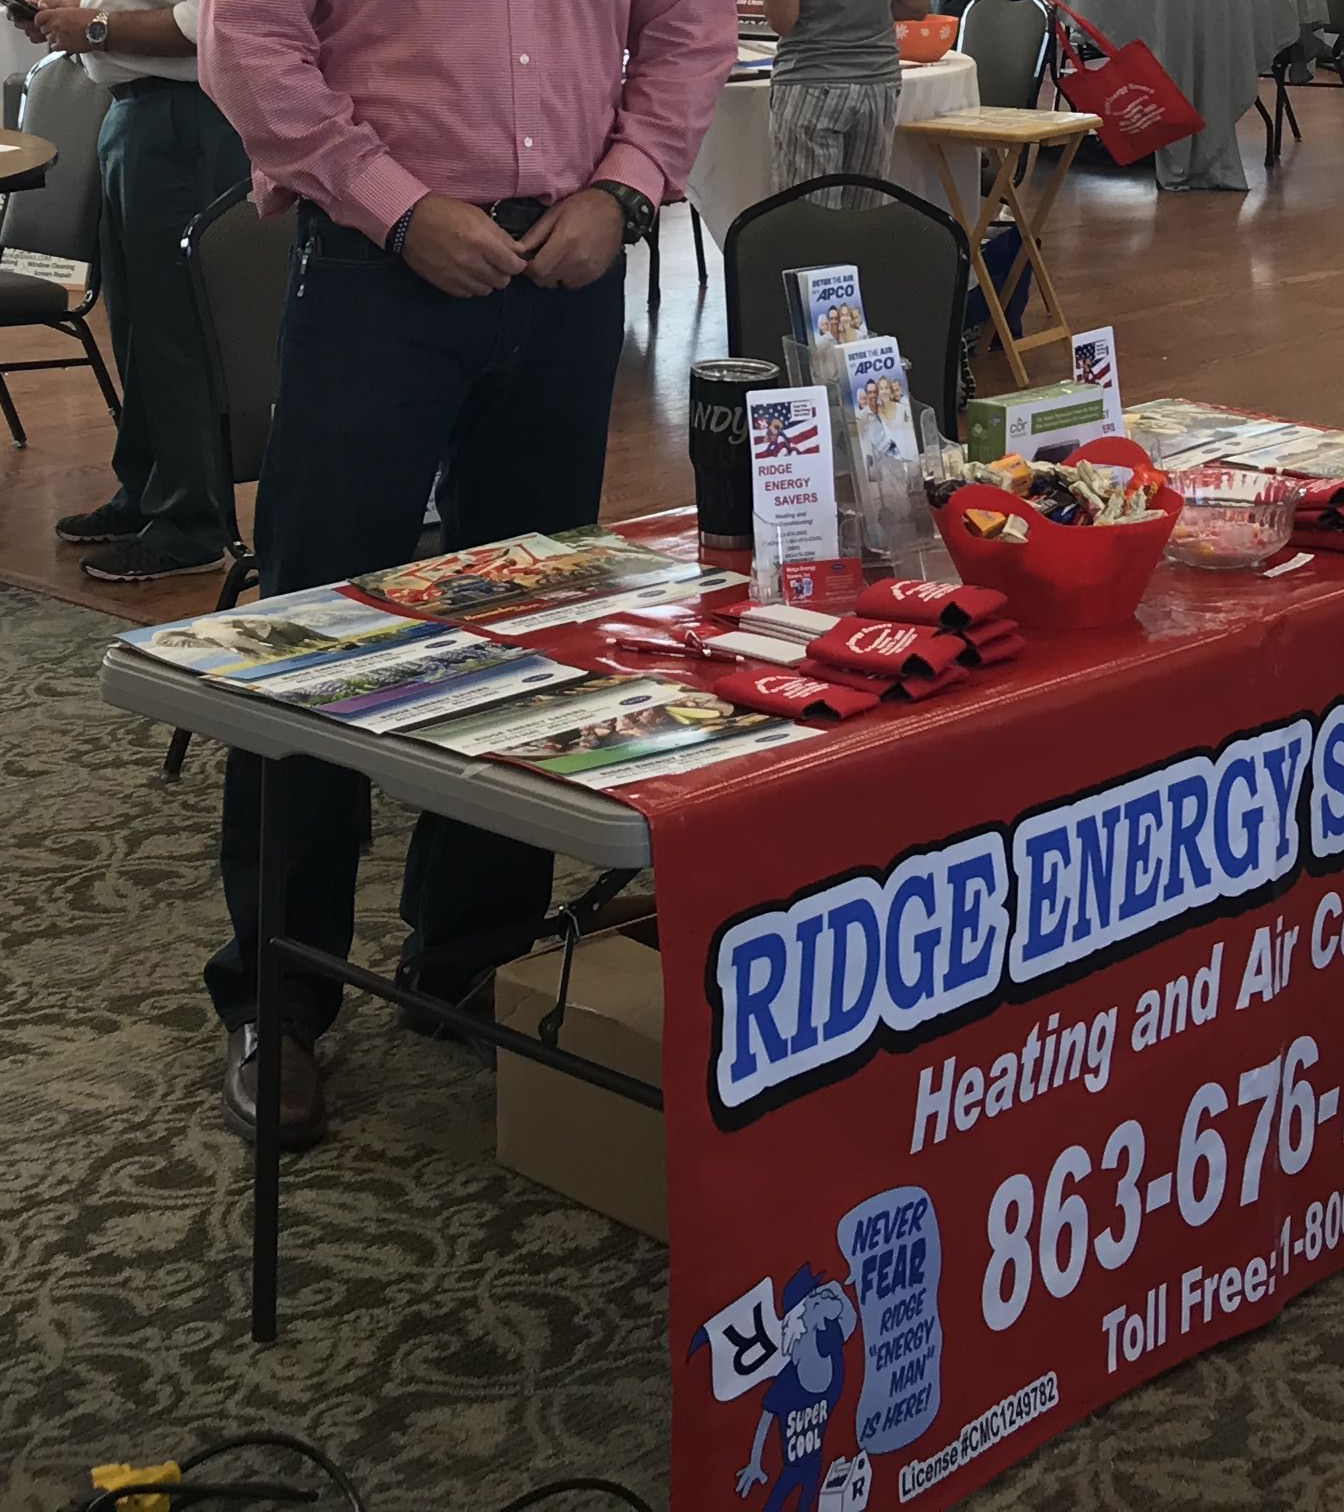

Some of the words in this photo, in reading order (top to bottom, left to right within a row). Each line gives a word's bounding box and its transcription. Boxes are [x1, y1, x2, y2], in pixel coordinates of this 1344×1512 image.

[816, 284, 855, 302] APCO
[855, 357, 895, 376] APCO
[758, 463, 793, 477] RIDGE
[765, 477, 811, 492] ENERGY
[774, 493, 818, 507] SAVERS
[729, 852, 1001, 1083] RIDGE
[1020, 735, 1304, 962] ENERGY
[910, 1005, 1118, 1155] Heating
[1131, 942, 1224, 1053] and
[1237, 925, 1298, 1010] Air
[852, 1197, 928, 1257] NEVER
[860, 1238, 927, 1305] FEAR
[879, 1289, 927, 1336] RIDGE
[1102, 1274, 1167, 1374] Toll
[786, 1399, 828, 1438] SUPER
[859, 1411, 880, 1442] IS
[883, 1383, 932, 1434] HERE!
[786, 1426, 821, 1462] COOL
[901, 1445, 958, 1498] License
[960, 1377, 1057, 1459] #CMC1249782
